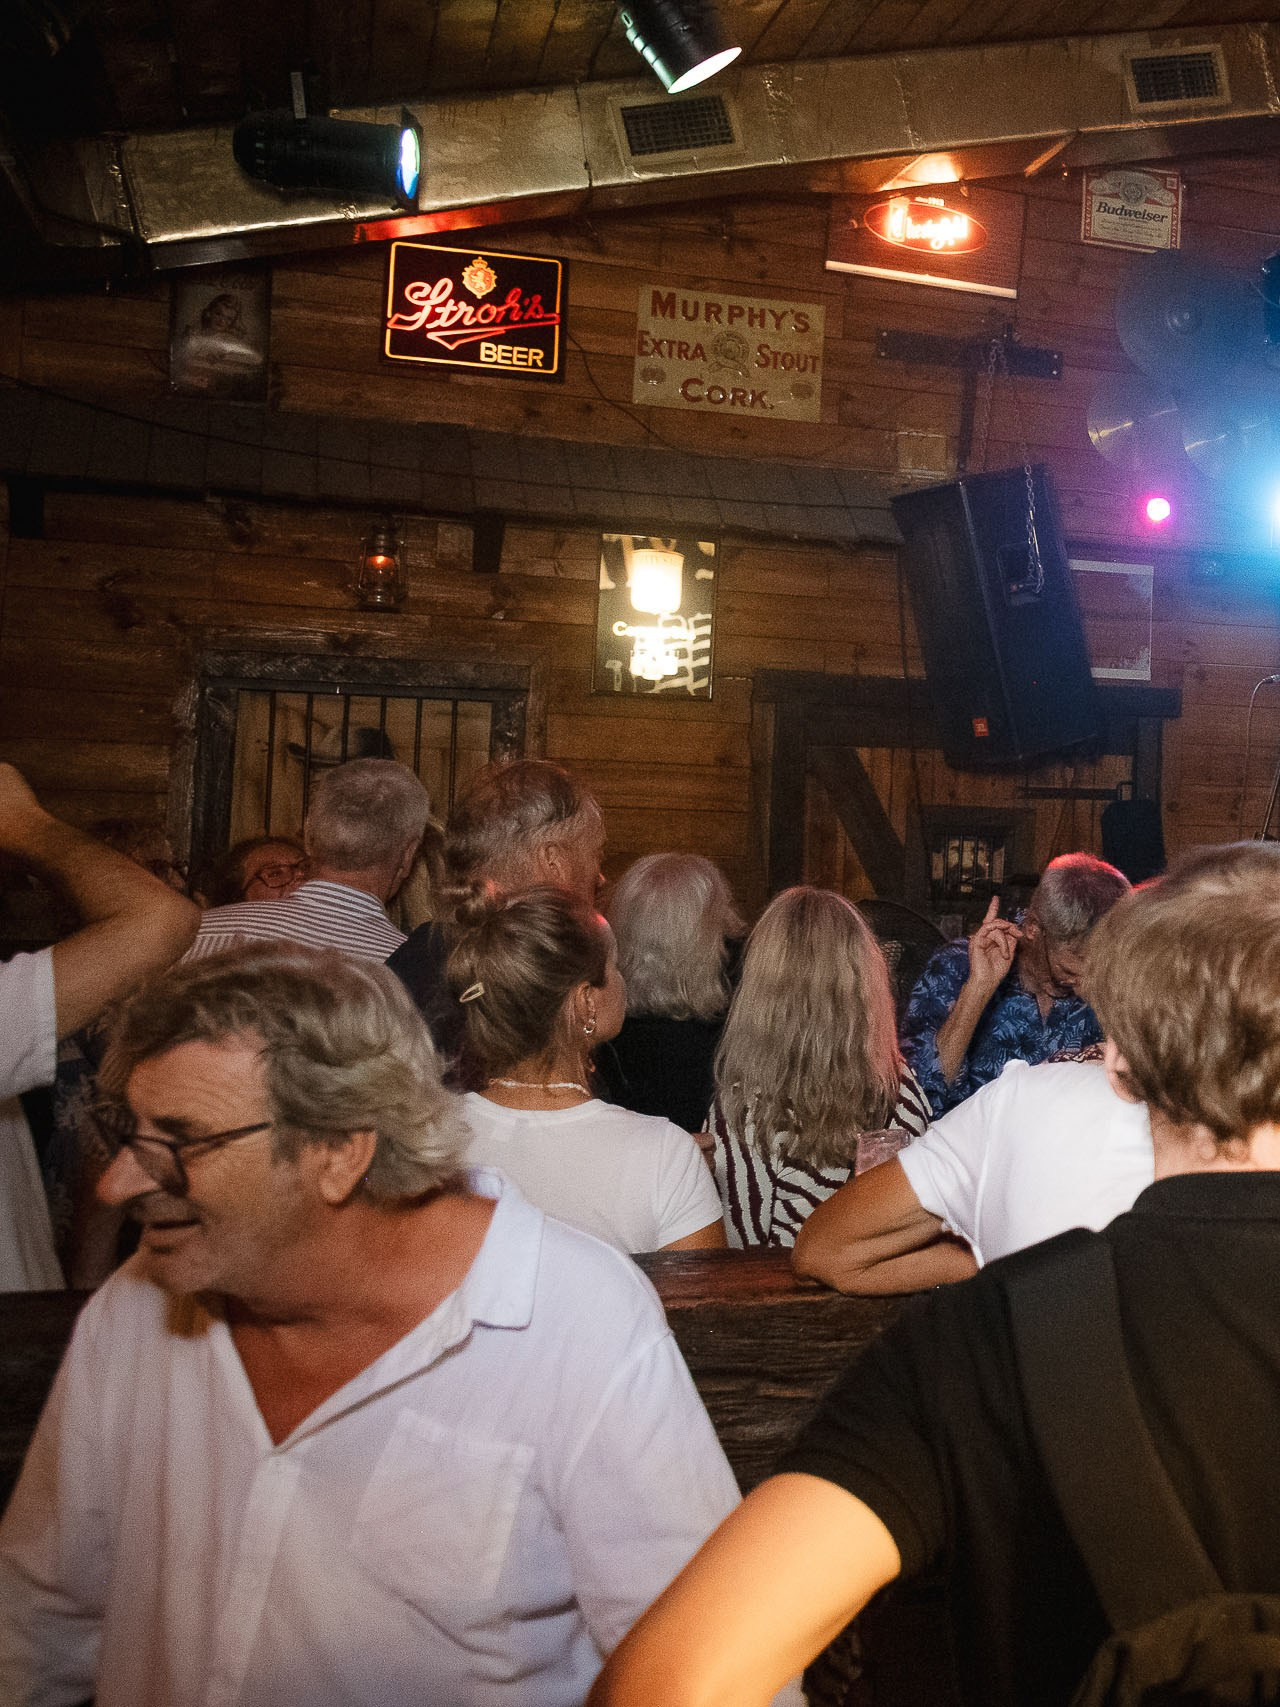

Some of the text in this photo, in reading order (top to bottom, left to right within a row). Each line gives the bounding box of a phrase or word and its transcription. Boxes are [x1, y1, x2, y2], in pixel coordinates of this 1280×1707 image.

[1096, 202, 1168, 223] Budweiser
[392, 278, 546, 331] Stroh's
[651, 290, 811, 333] MURPHY'S
[480, 341, 544, 367] BEER
[637, 330, 820, 374] EXTRA STOUT
